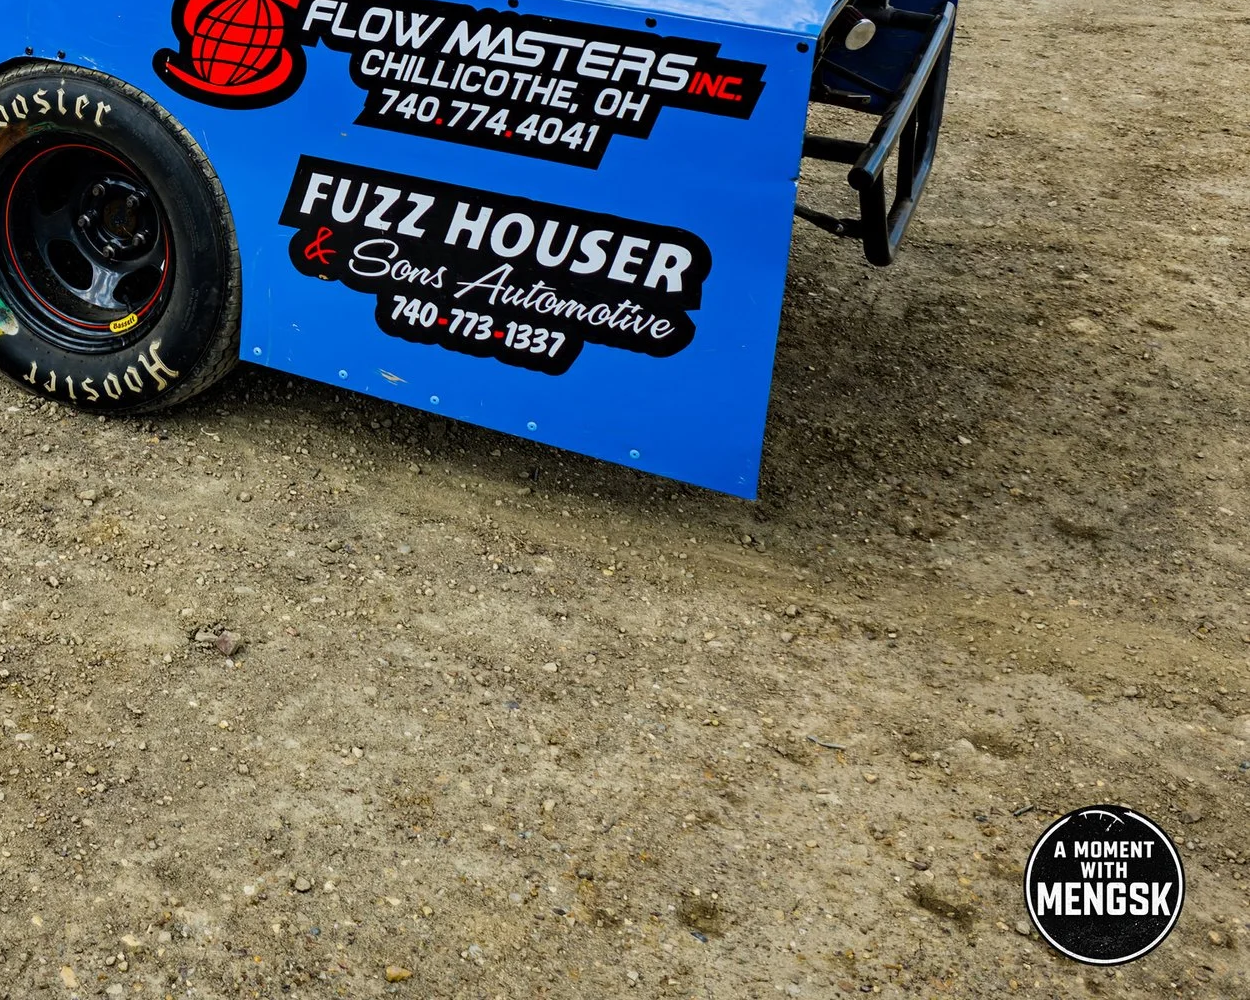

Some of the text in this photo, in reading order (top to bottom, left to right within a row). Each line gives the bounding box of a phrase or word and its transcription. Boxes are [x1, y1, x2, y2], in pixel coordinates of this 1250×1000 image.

[360, 49, 650, 123] CHILLICOTHE, OH
[441, 20, 699, 92] MASTERS
[688, 71, 743, 101] INC.
[378, 88, 600, 153] 740.774.4041
[299, 172, 693, 293] FUZZ HOUSER
[304, 226, 676, 340] & Sons Automotive
[391, 295, 566, 358] 740-773-1337
[23, 340, 180, 402] Hoosier
